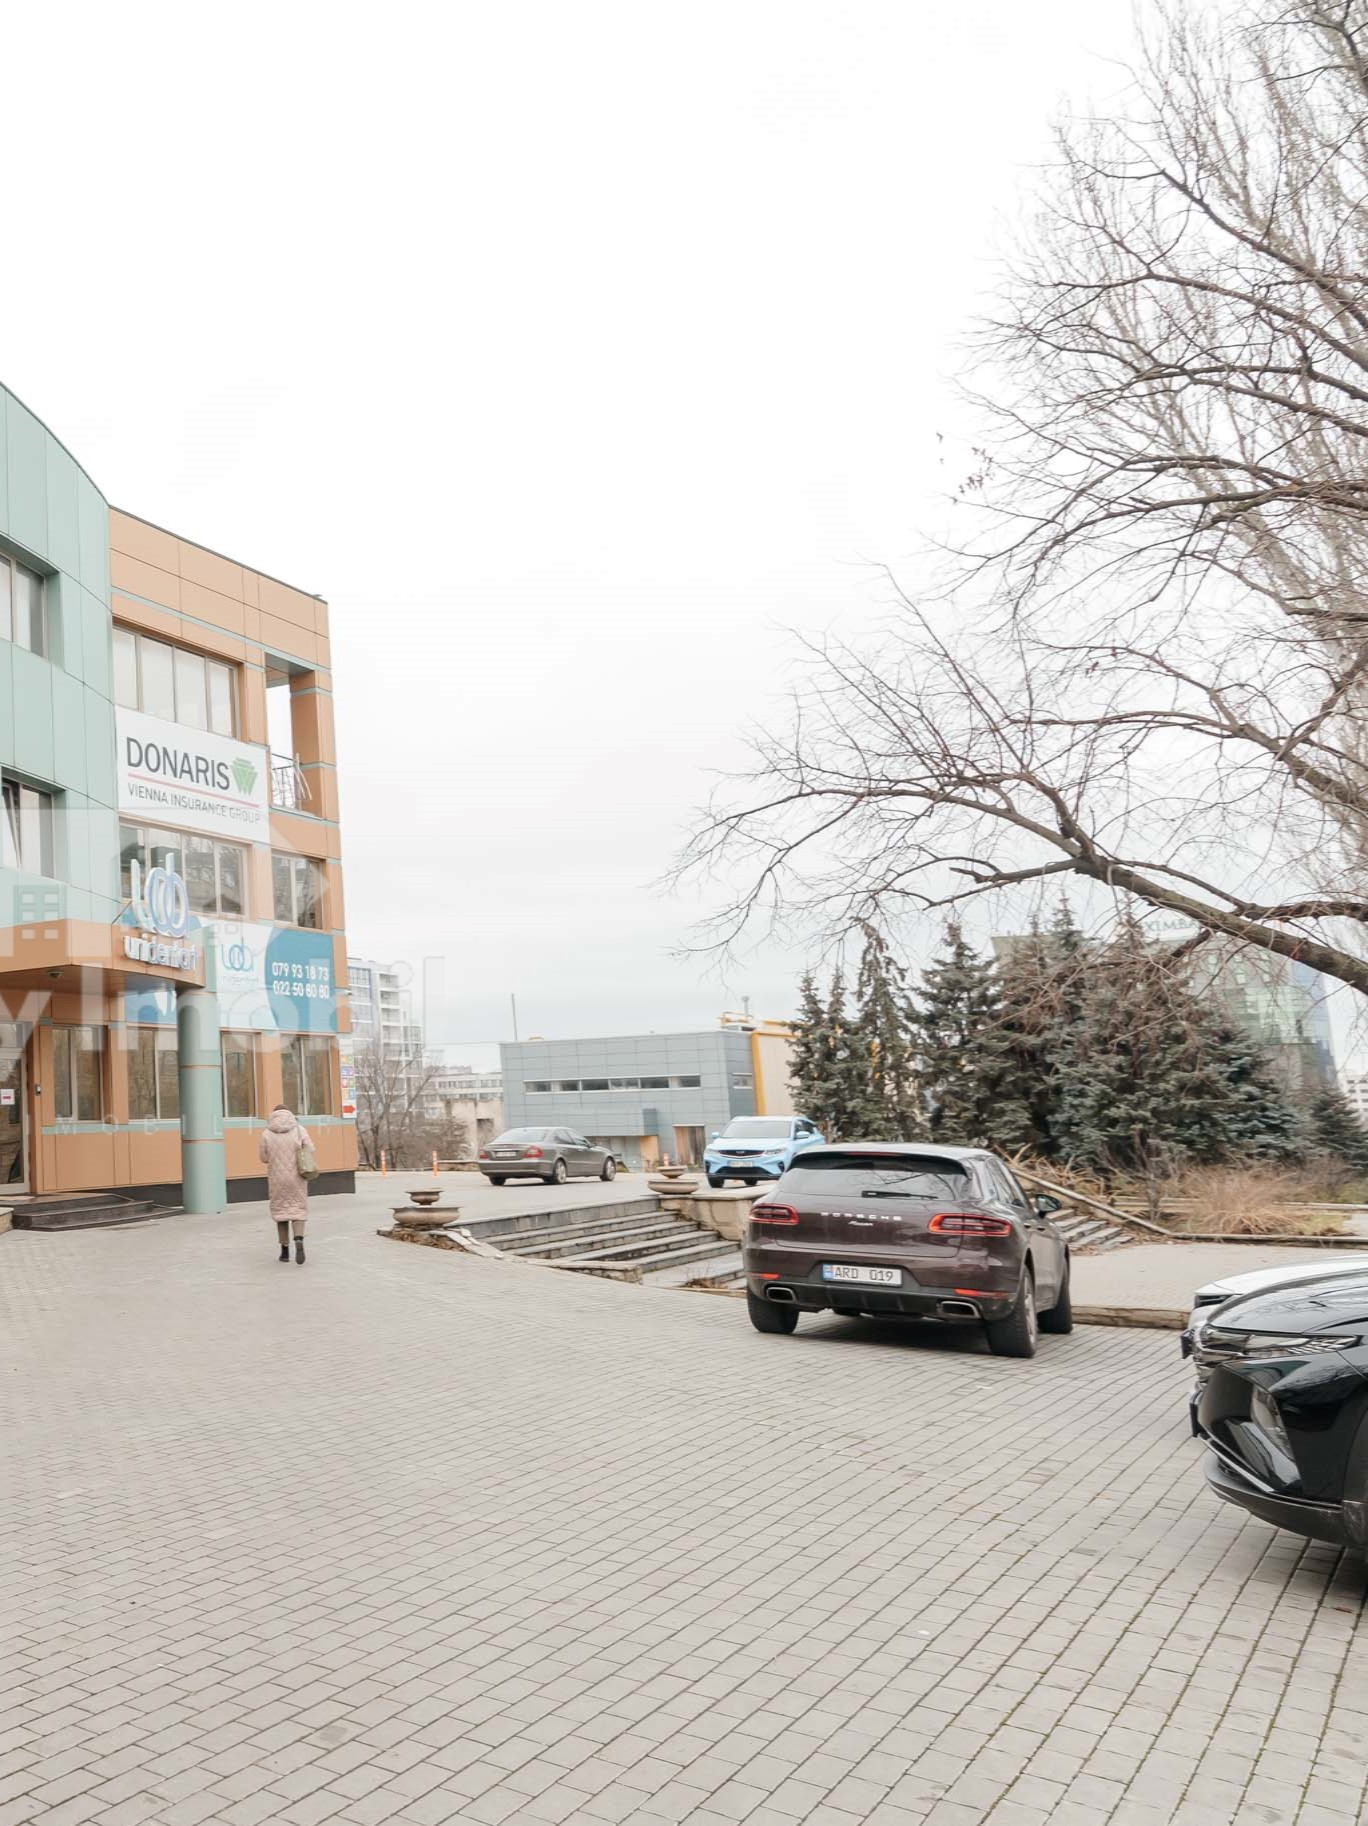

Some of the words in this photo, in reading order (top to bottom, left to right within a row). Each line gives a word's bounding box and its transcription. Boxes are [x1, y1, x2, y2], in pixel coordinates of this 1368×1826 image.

[127, 736, 231, 790] DONARIS
[128, 783, 169, 805] VIENNA
[170, 795, 230, 818] INSURANCE
[229, 807, 262, 825] GROUP
[272, 961, 290, 977] 079
[292, 963, 304, 979] 93
[305, 965, 317, 981] 18
[318, 966, 330, 982] 73
[273, 980, 291, 996] 022
[292, 982, 305, 997] 50
[305, 983, 317, 999] 80
[318, 984, 330, 1000] 80
[821, 1212, 902, 1221] PORSCHE
[834, 1267, 859, 1279] ARD
[869, 1269, 894, 1281] 019
